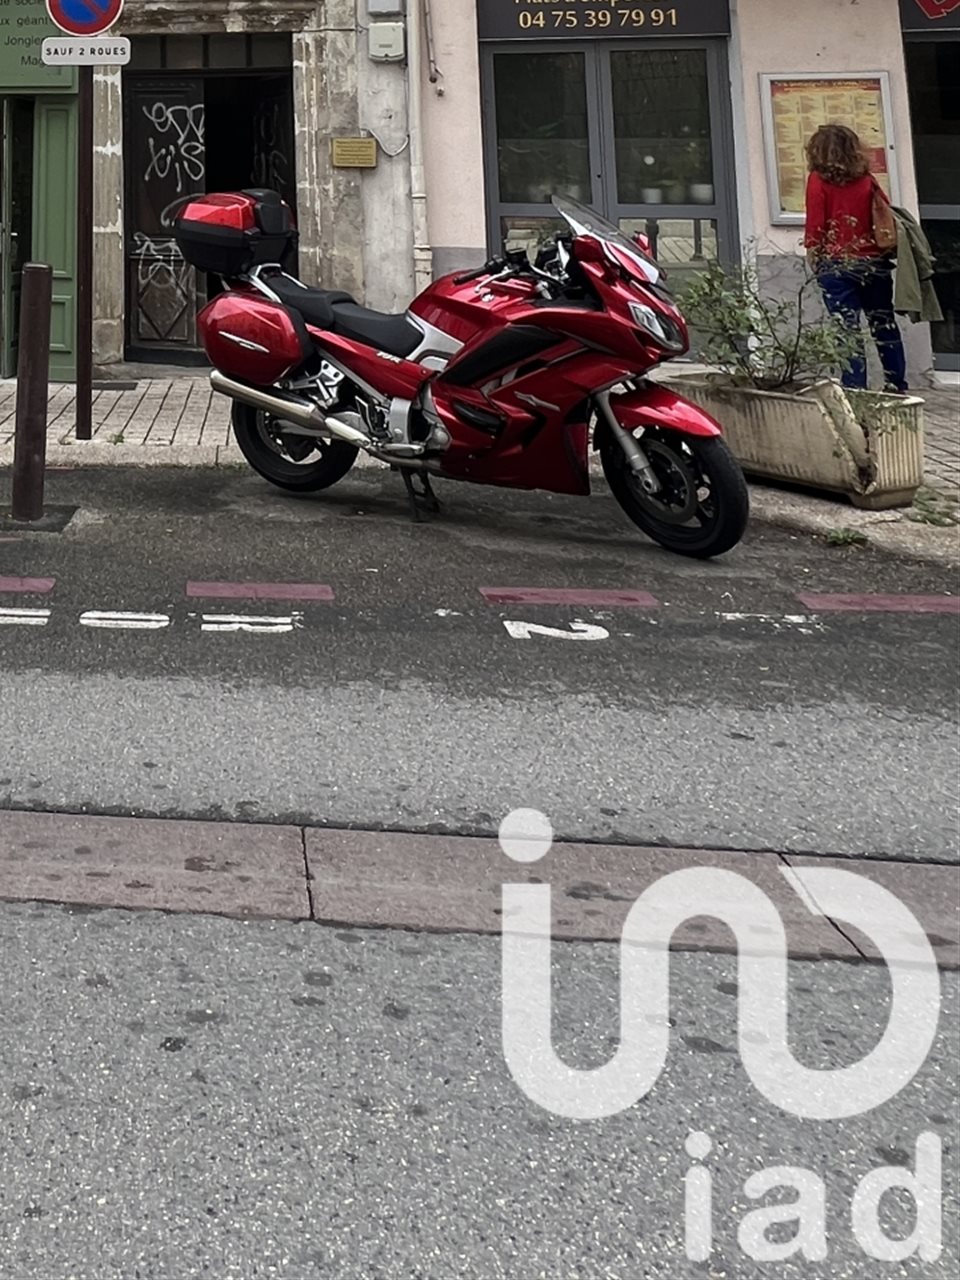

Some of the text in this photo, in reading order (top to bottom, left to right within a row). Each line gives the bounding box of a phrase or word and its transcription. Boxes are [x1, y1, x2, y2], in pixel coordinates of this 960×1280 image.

[17, 16, 50, 28] géant
[519, 8, 677, 29] 04 75 39 79 91
[4, 36, 43, 48] Jongle
[46, 47, 126, 56] SAUF 2 ROUES
